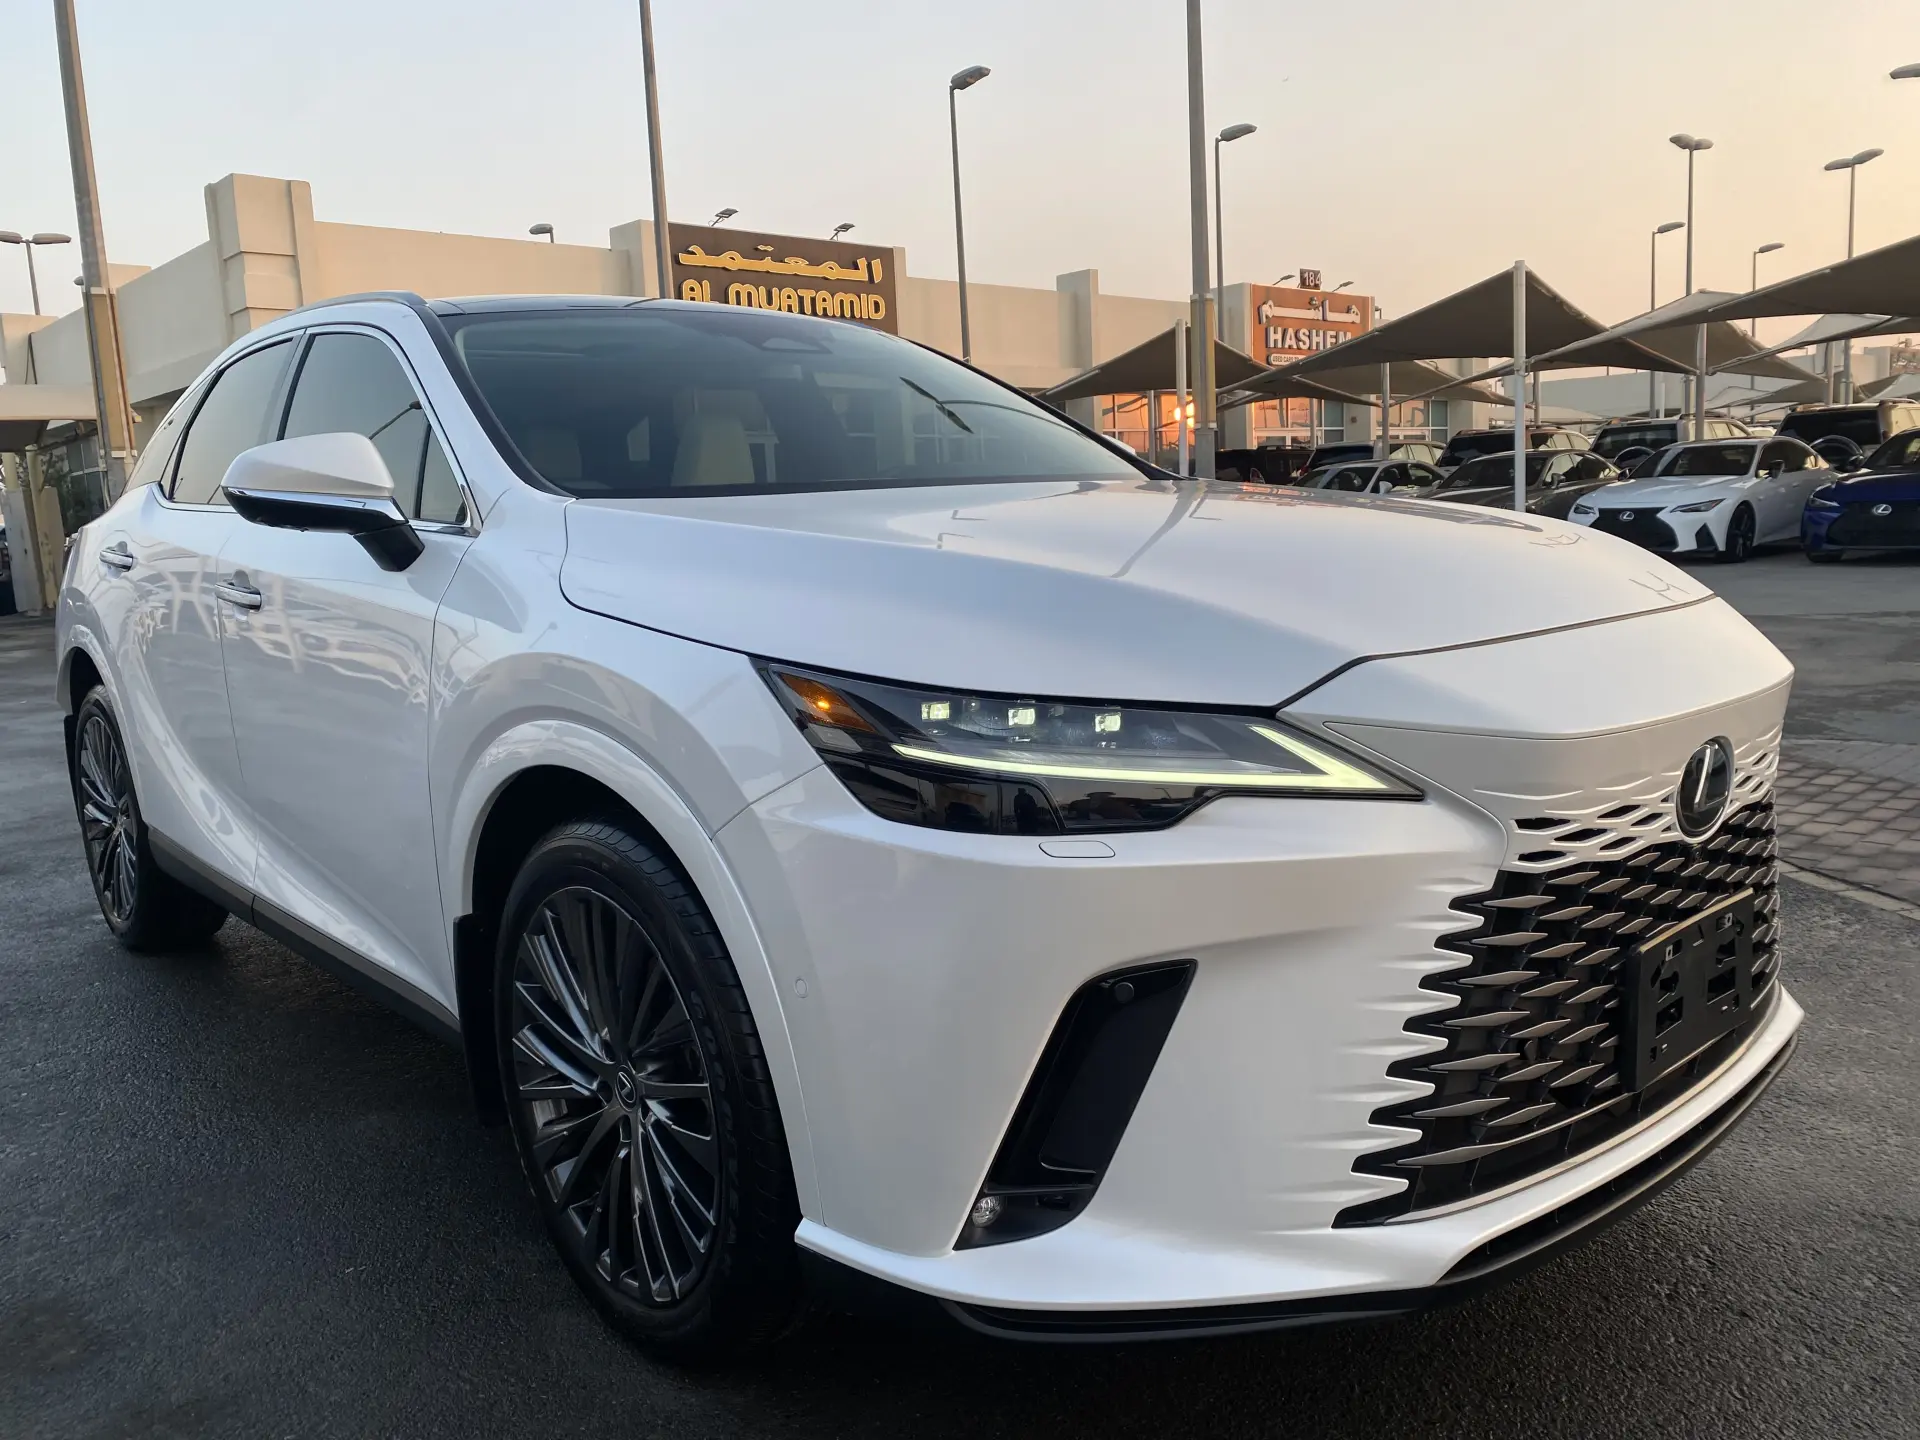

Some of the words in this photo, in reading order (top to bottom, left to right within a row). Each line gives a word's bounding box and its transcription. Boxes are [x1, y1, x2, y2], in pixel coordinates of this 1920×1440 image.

[679, 244, 882, 284] المعتمد
[1304, 271, 1321, 286] 184
[729, 283, 885, 320] MUATAMID
[1260, 296, 1361, 324] هاشم
[1269, 326, 1352, 351] HASHEM
